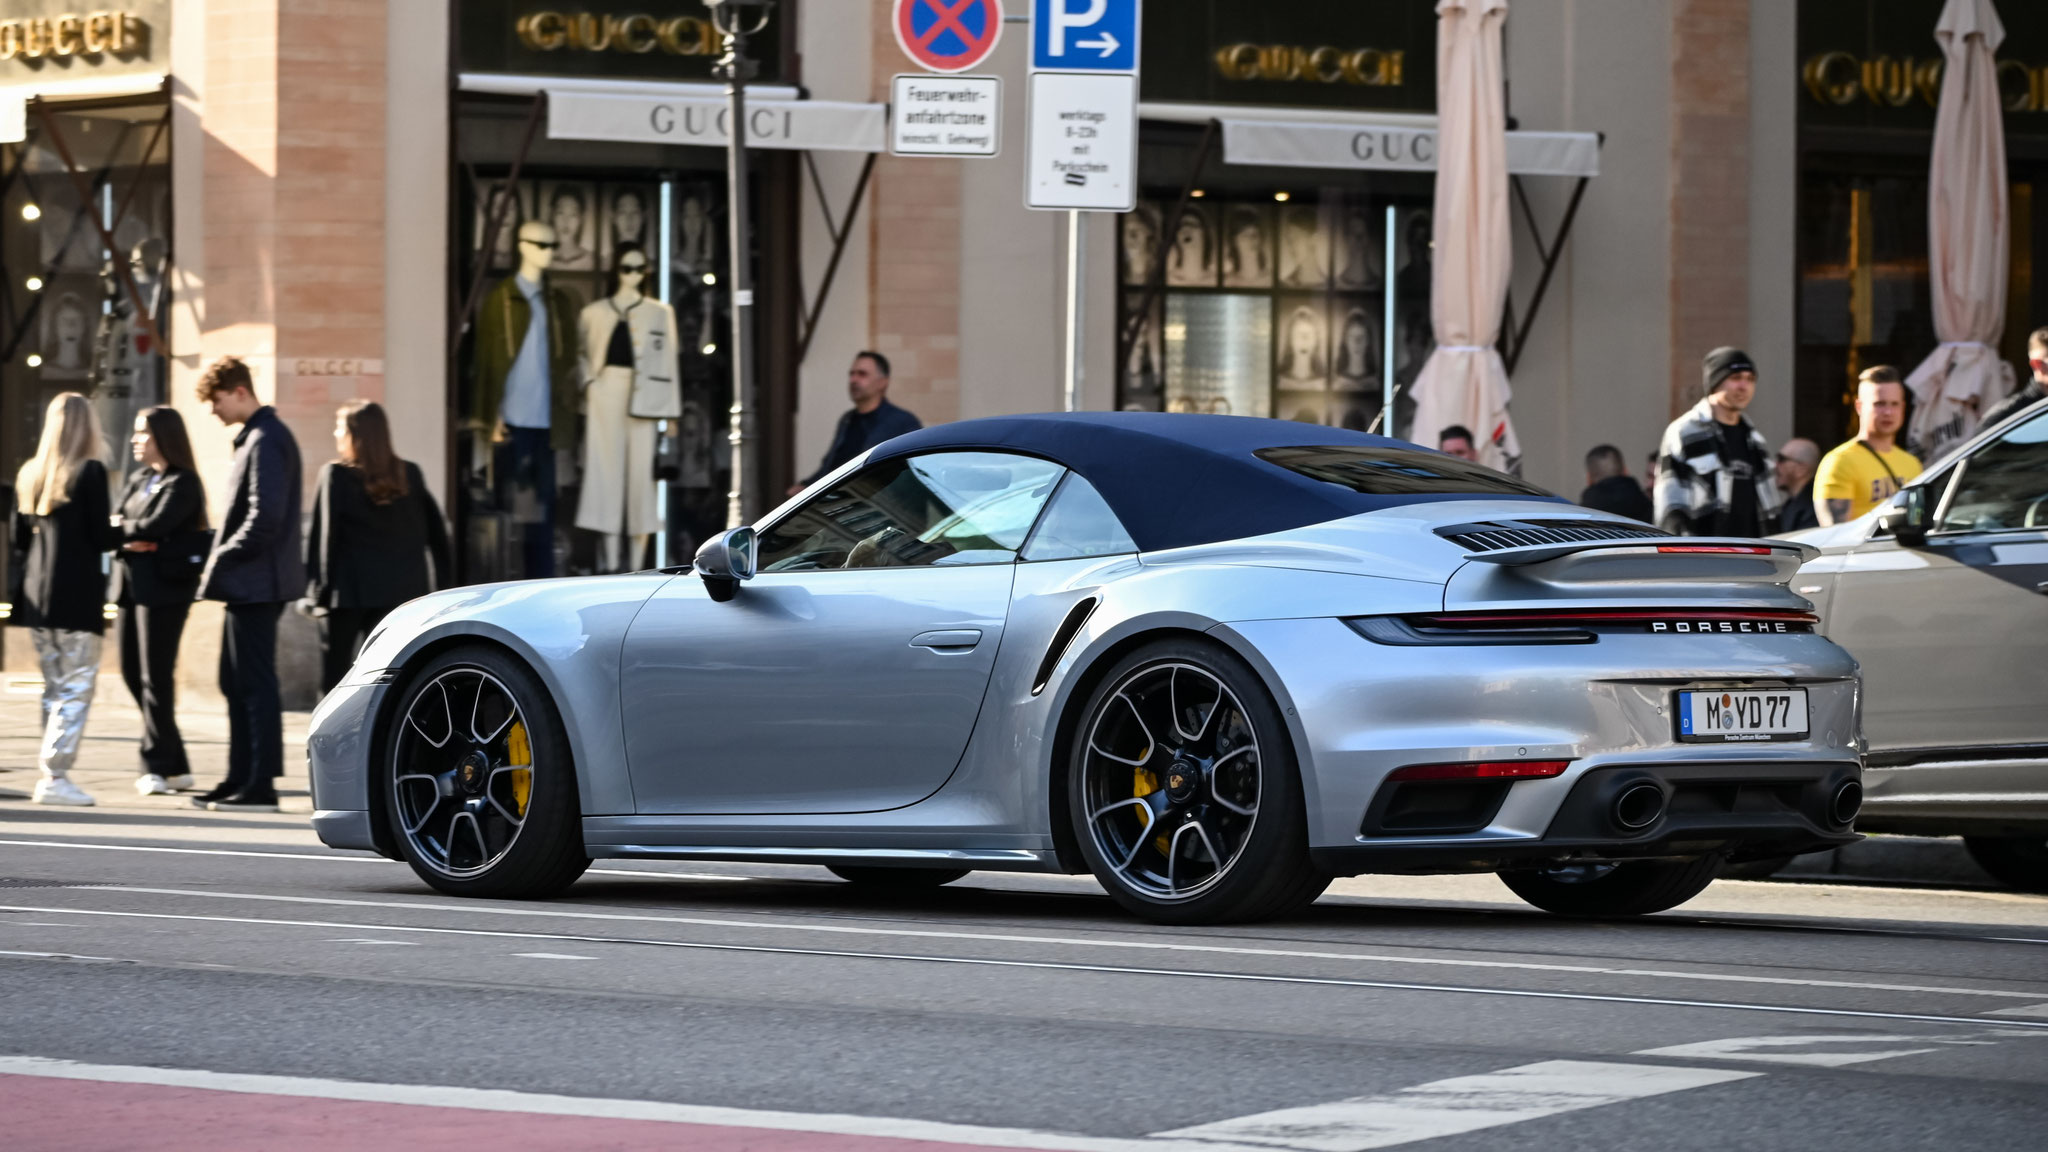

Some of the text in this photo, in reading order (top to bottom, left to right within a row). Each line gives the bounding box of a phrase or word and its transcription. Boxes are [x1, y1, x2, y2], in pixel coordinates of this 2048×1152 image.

[1048, 0, 1108, 57] P
[907, 85, 988, 102] Feuerwehr-
[905, 108, 985, 125] anfahrtzone
[1351, 131, 1433, 162] GUC
[1652, 622, 1787, 633] PORSCHE
[1683, 718, 1690, 728] D
